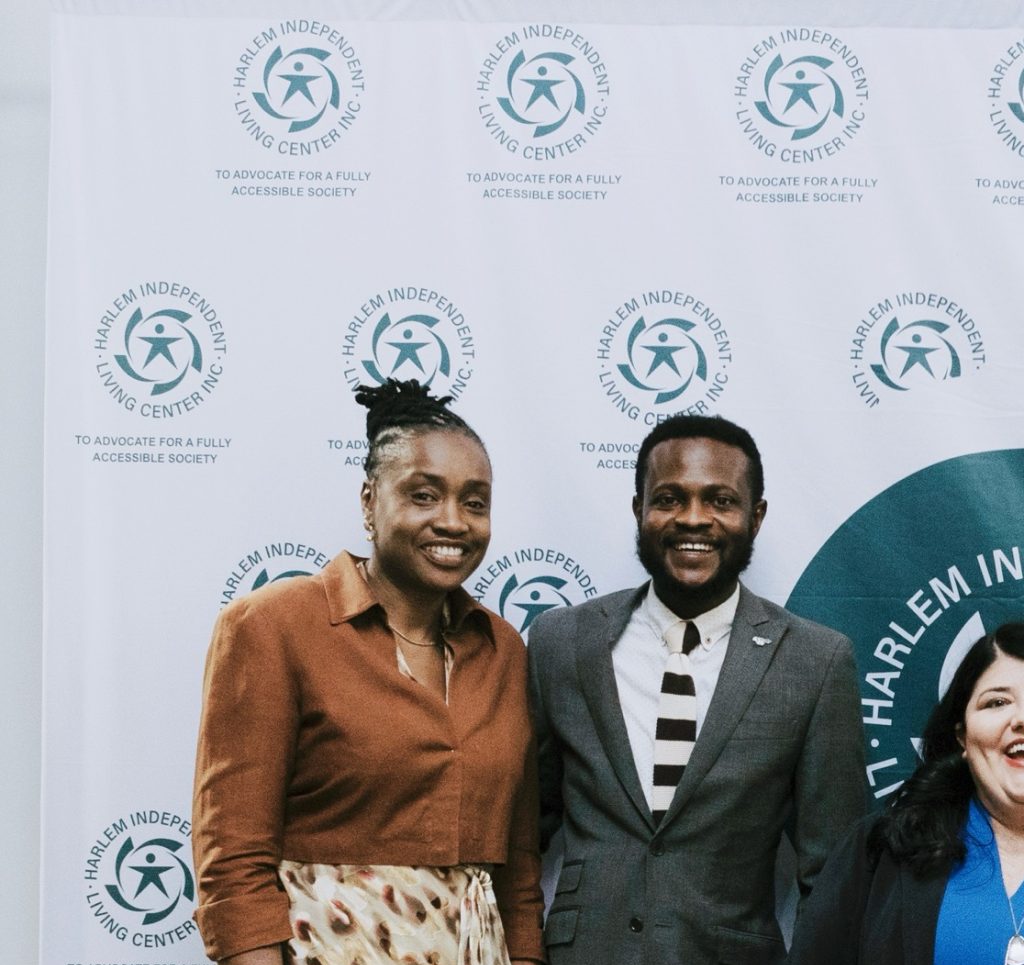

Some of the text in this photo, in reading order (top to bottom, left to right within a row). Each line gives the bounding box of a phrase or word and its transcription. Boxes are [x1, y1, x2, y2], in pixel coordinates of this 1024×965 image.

[233, 20, 364, 91] HARLEM INDEPENDENT
[477, 24, 609, 95] HARLEM INDEPENDENT
[734, 28, 868, 100] HARLEM INDEPENDENT
[235, 100, 274, 148] LIVING
[278, 129, 341, 155] CENTER
[479, 104, 519, 153] LIVING
[523, 134, 586, 160] CENTER
[736, 109, 776, 157] LIVING
[781, 137, 845, 163] CENTER
[214, 169, 371, 181] TO ADVOCATE FOR A FULLY
[230, 185, 357, 198] ACCESSIBLE SOCIETY
[465, 172, 621, 184] TO ADVOCATE FOR A FULLY
[480, 188, 607, 201] ACCESSIBLE SOCIETY
[718, 176, 877, 187] TO ADVOCATE FOR A FULLY
[735, 192, 863, 203] ACCESSIBLE SOCIETY
[974, 178, 991, 189] TO
[94, 282, 226, 354] HARLEM INDEPENDENT
[342, 287, 474, 358] HARLEM INDEPENDENT
[597, 291, 732, 362] HARLEM INDEPENDENT
[850, 292, 985, 363] HARLEM INDEPENDENT
[97, 362, 136, 411] LIVING
[141, 392, 204, 418] CENTER
[599, 372, 640, 420] LIVING
[75, 435, 231, 447] TO ADVOCATE FOR A FULLY
[92, 452, 217, 464] ACCESSIBLE SOCIETY
[580, 442, 640, 453] TO ADVOC
[863, 565, 972, 726] HARLEM
[85, 810, 192, 880] HARLEM INDEPE
[87, 893, 196, 947] LIVING CENTER
